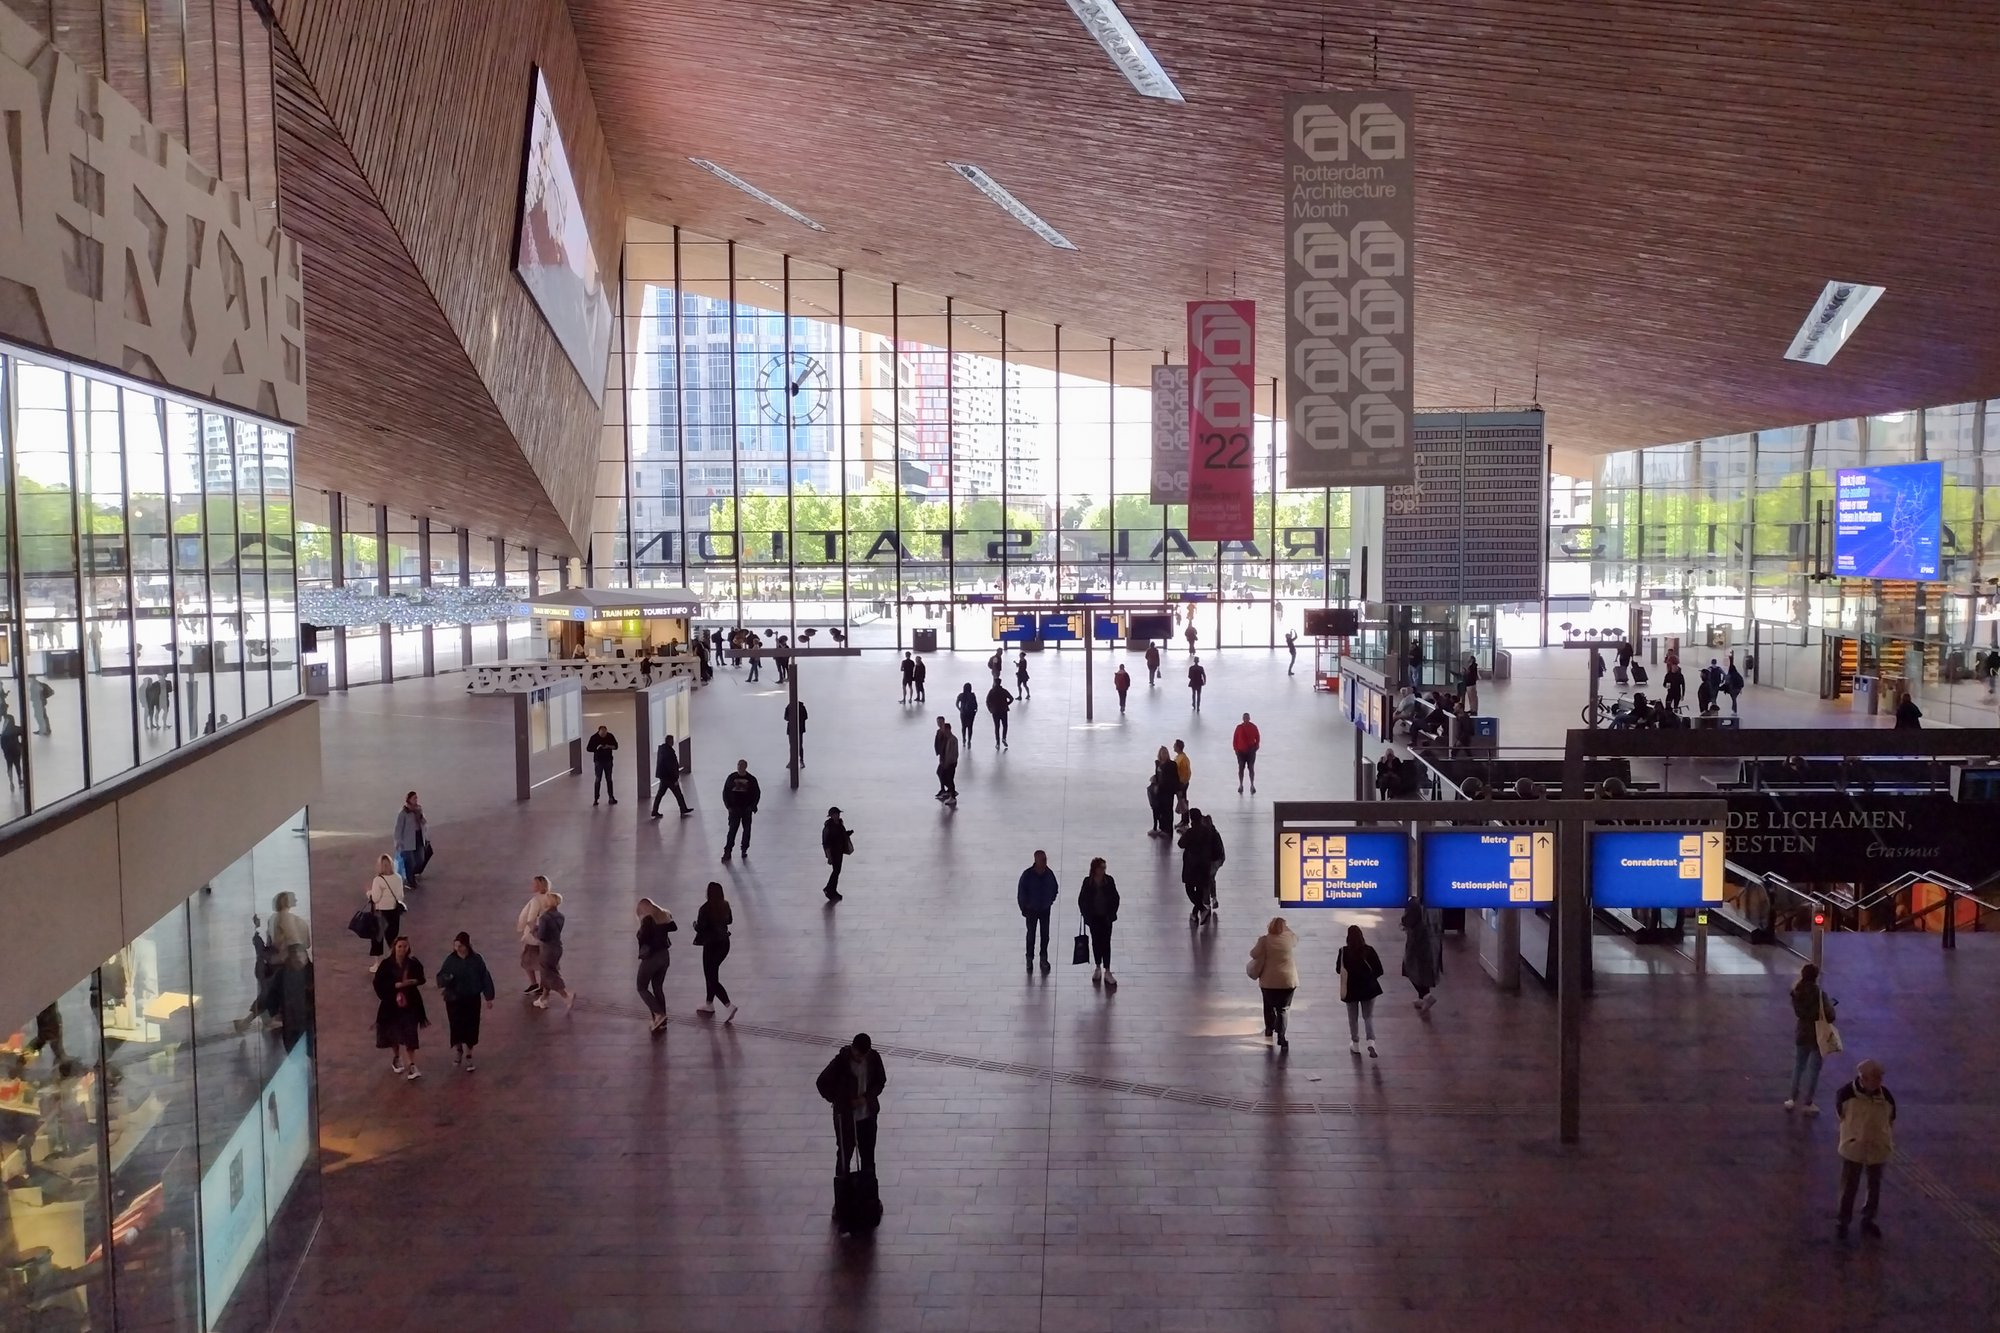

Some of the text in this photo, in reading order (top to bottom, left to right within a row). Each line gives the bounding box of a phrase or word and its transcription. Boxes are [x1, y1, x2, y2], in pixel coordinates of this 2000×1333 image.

[1293, 164, 1384, 182] Rotterdam
[1292, 182, 1397, 200] Architecture
[1293, 199, 1349, 218] Month
[1199, 433, 1250, 469] '22
[602, 606, 688, 618] TRAIN INFO TOURIST INFO
[1768, 810, 1912, 831] LICHAMEN,
[1481, 836, 1508, 844] Metro
[1866, 842, 1940, 858] Erasmus
[1348, 858, 1380, 867] Service
[1621, 858, 1678, 867] Conradstraat
[1306, 869, 1322, 877] WC
[1326, 880, 1378, 891] Delftseplein
[1452, 880, 1508, 891] Stationsplein
[1326, 890, 1362, 900] Lijnbaan
